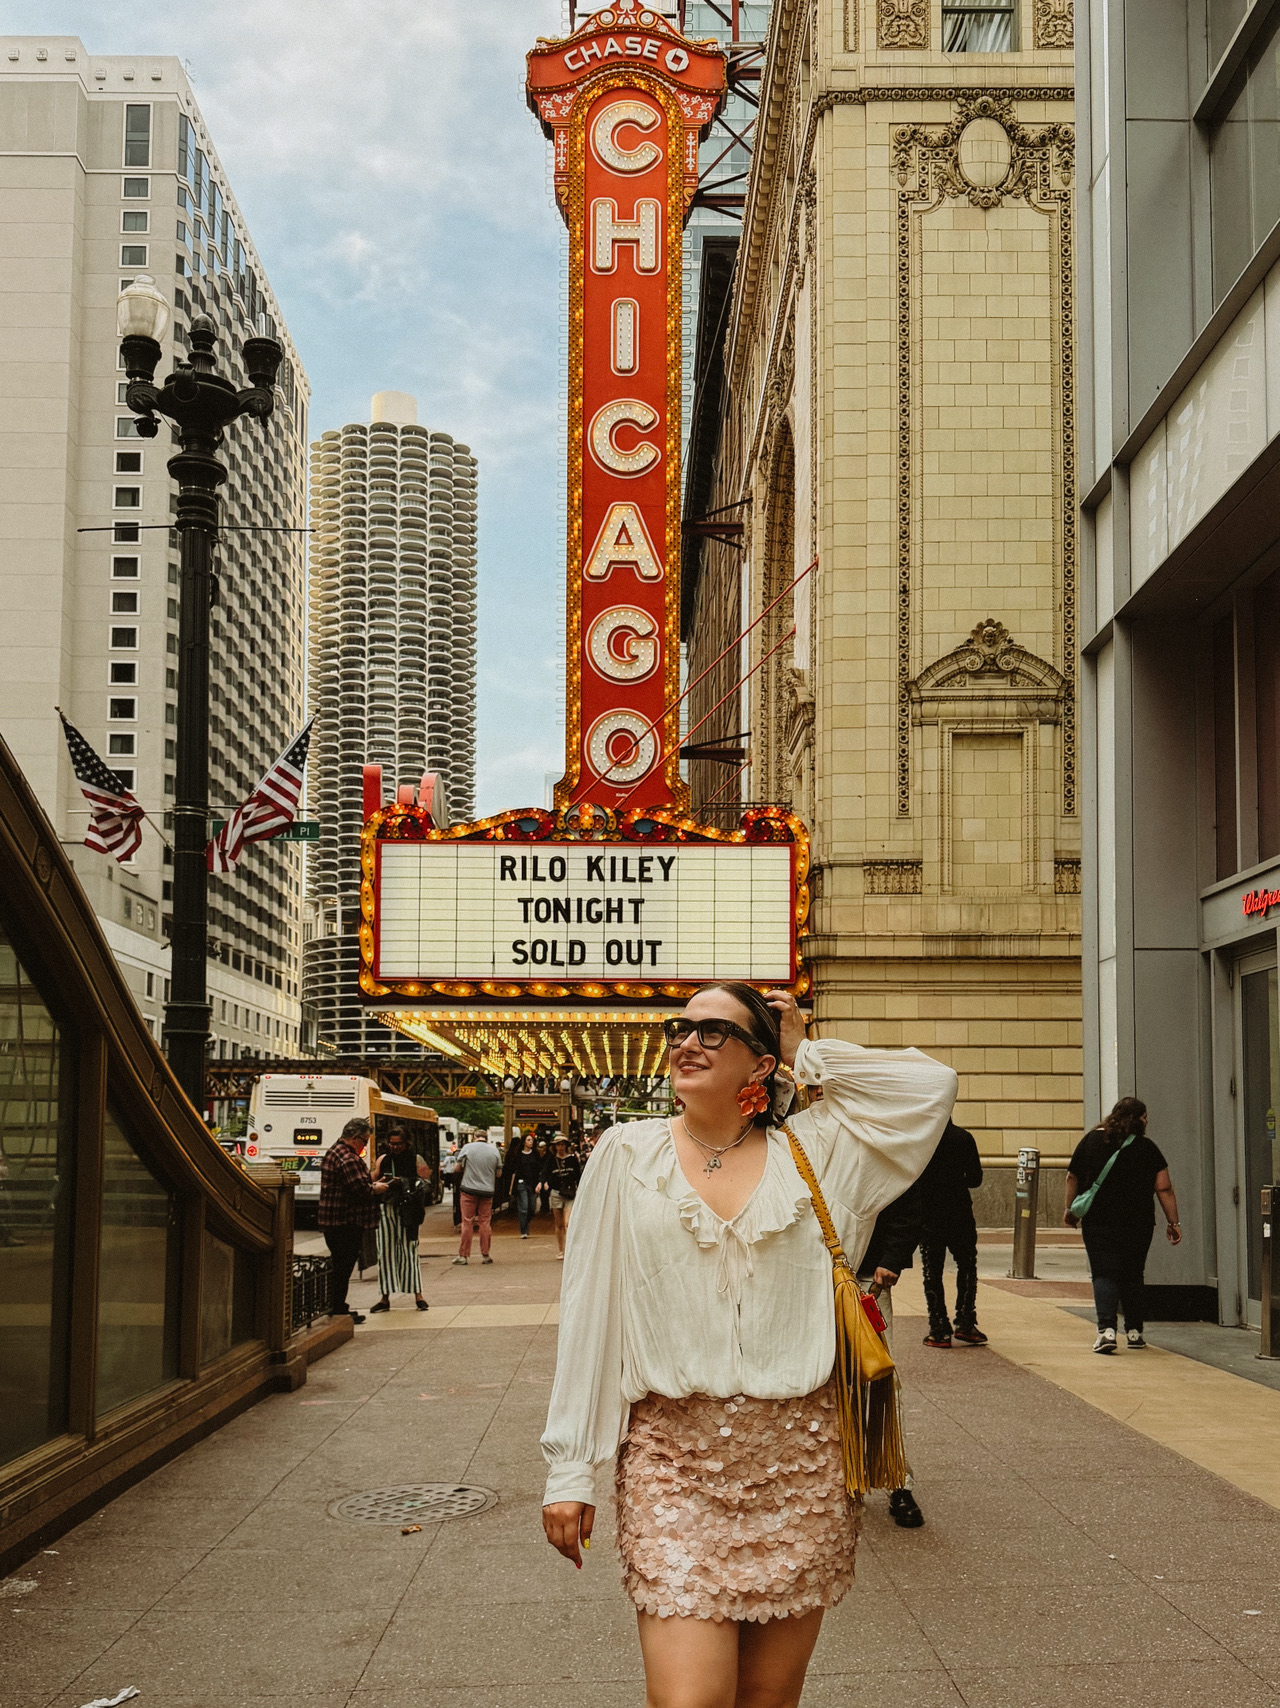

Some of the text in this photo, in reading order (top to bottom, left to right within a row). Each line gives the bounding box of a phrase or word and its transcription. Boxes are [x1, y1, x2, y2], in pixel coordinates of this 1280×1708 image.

[564, 36, 662, 72] CHASE
[584, 99, 663, 788] CHICAGO
[500, 855, 676, 884] RILO KILEY
[517, 897, 645, 924] TONIGHT
[512, 939, 663, 967] SOLD OUT
